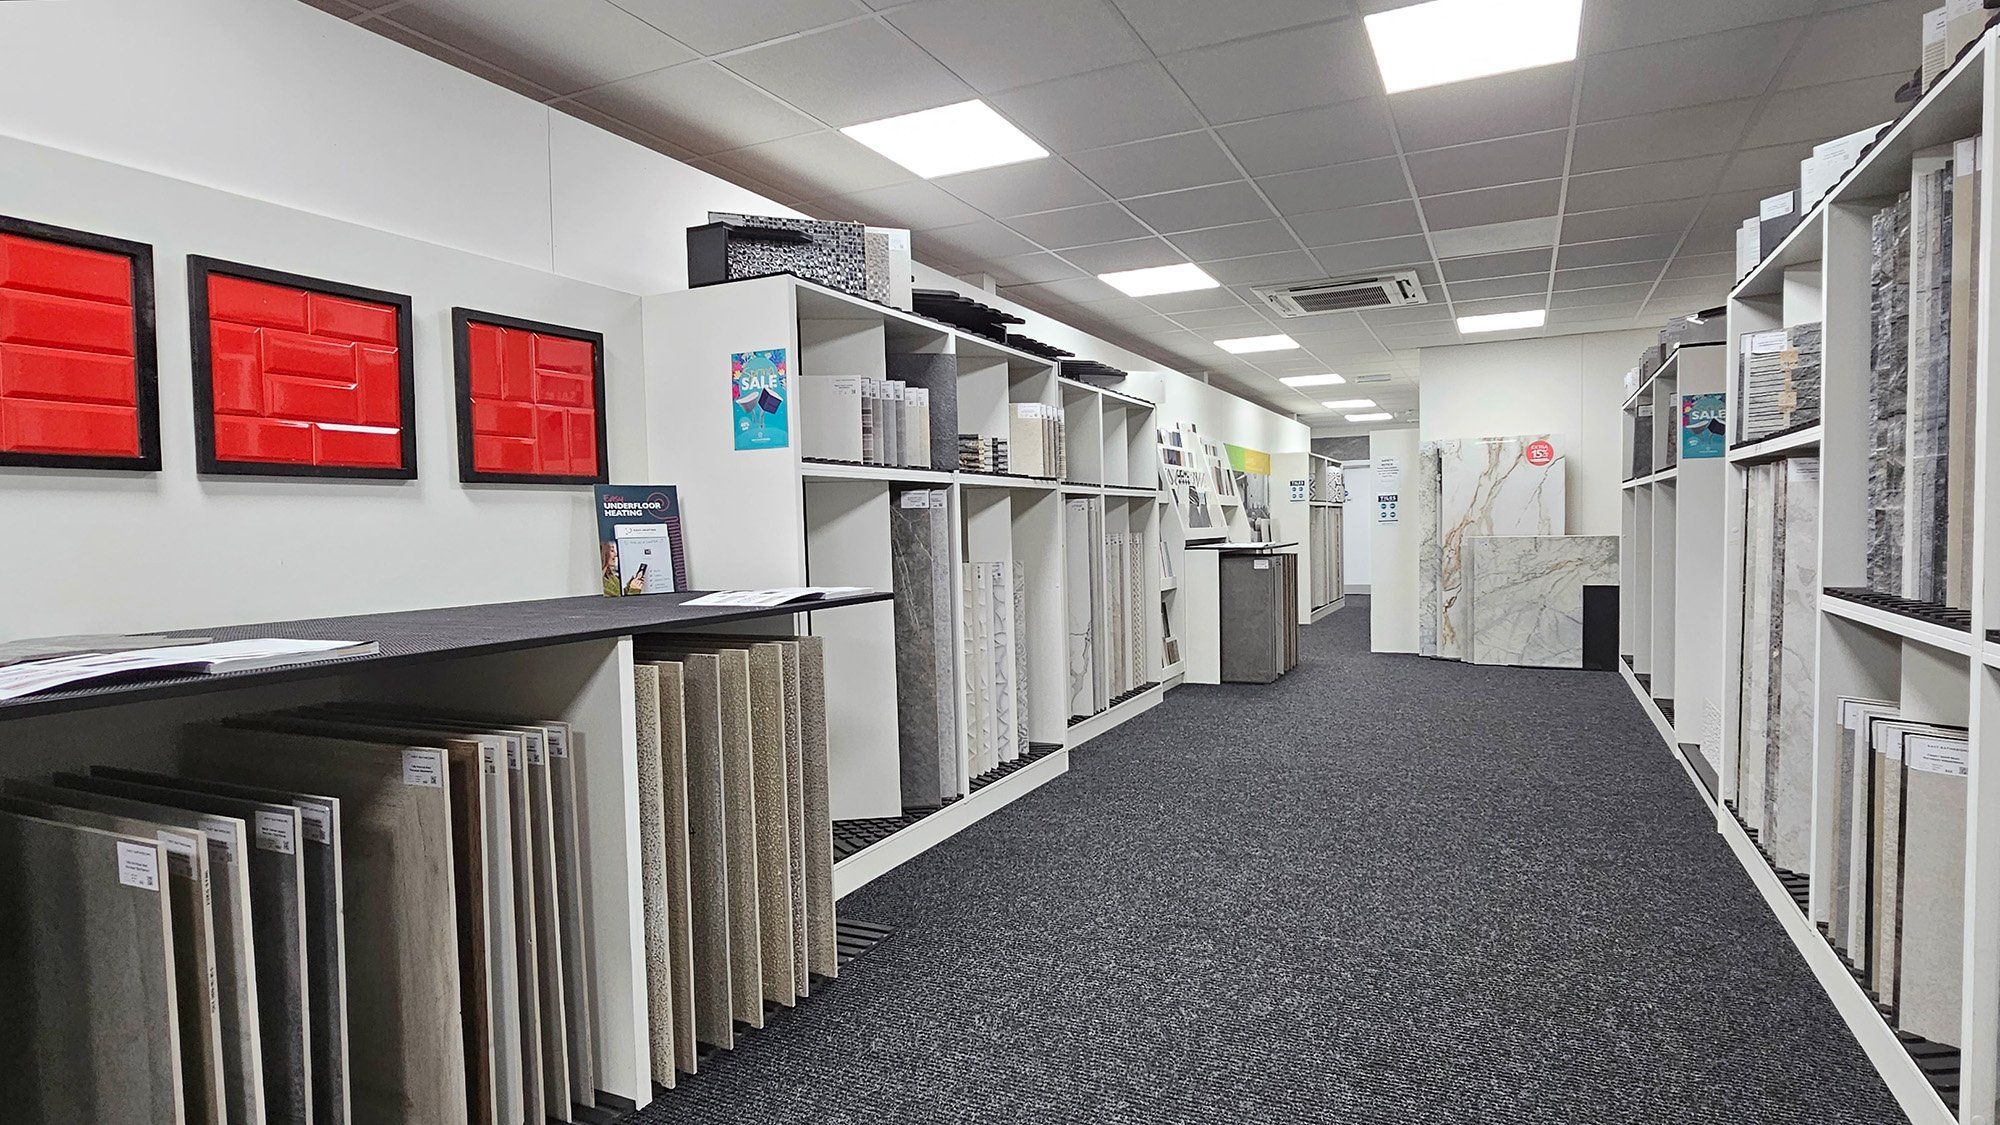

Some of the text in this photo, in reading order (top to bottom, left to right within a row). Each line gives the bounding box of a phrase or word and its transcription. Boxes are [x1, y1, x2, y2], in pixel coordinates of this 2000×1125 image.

[741, 375, 777, 390] SALE
[1692, 410, 1726, 420] SALE
[603, 502, 661, 510] UNDERFLOOR
[604, 509, 643, 517] HEATING
